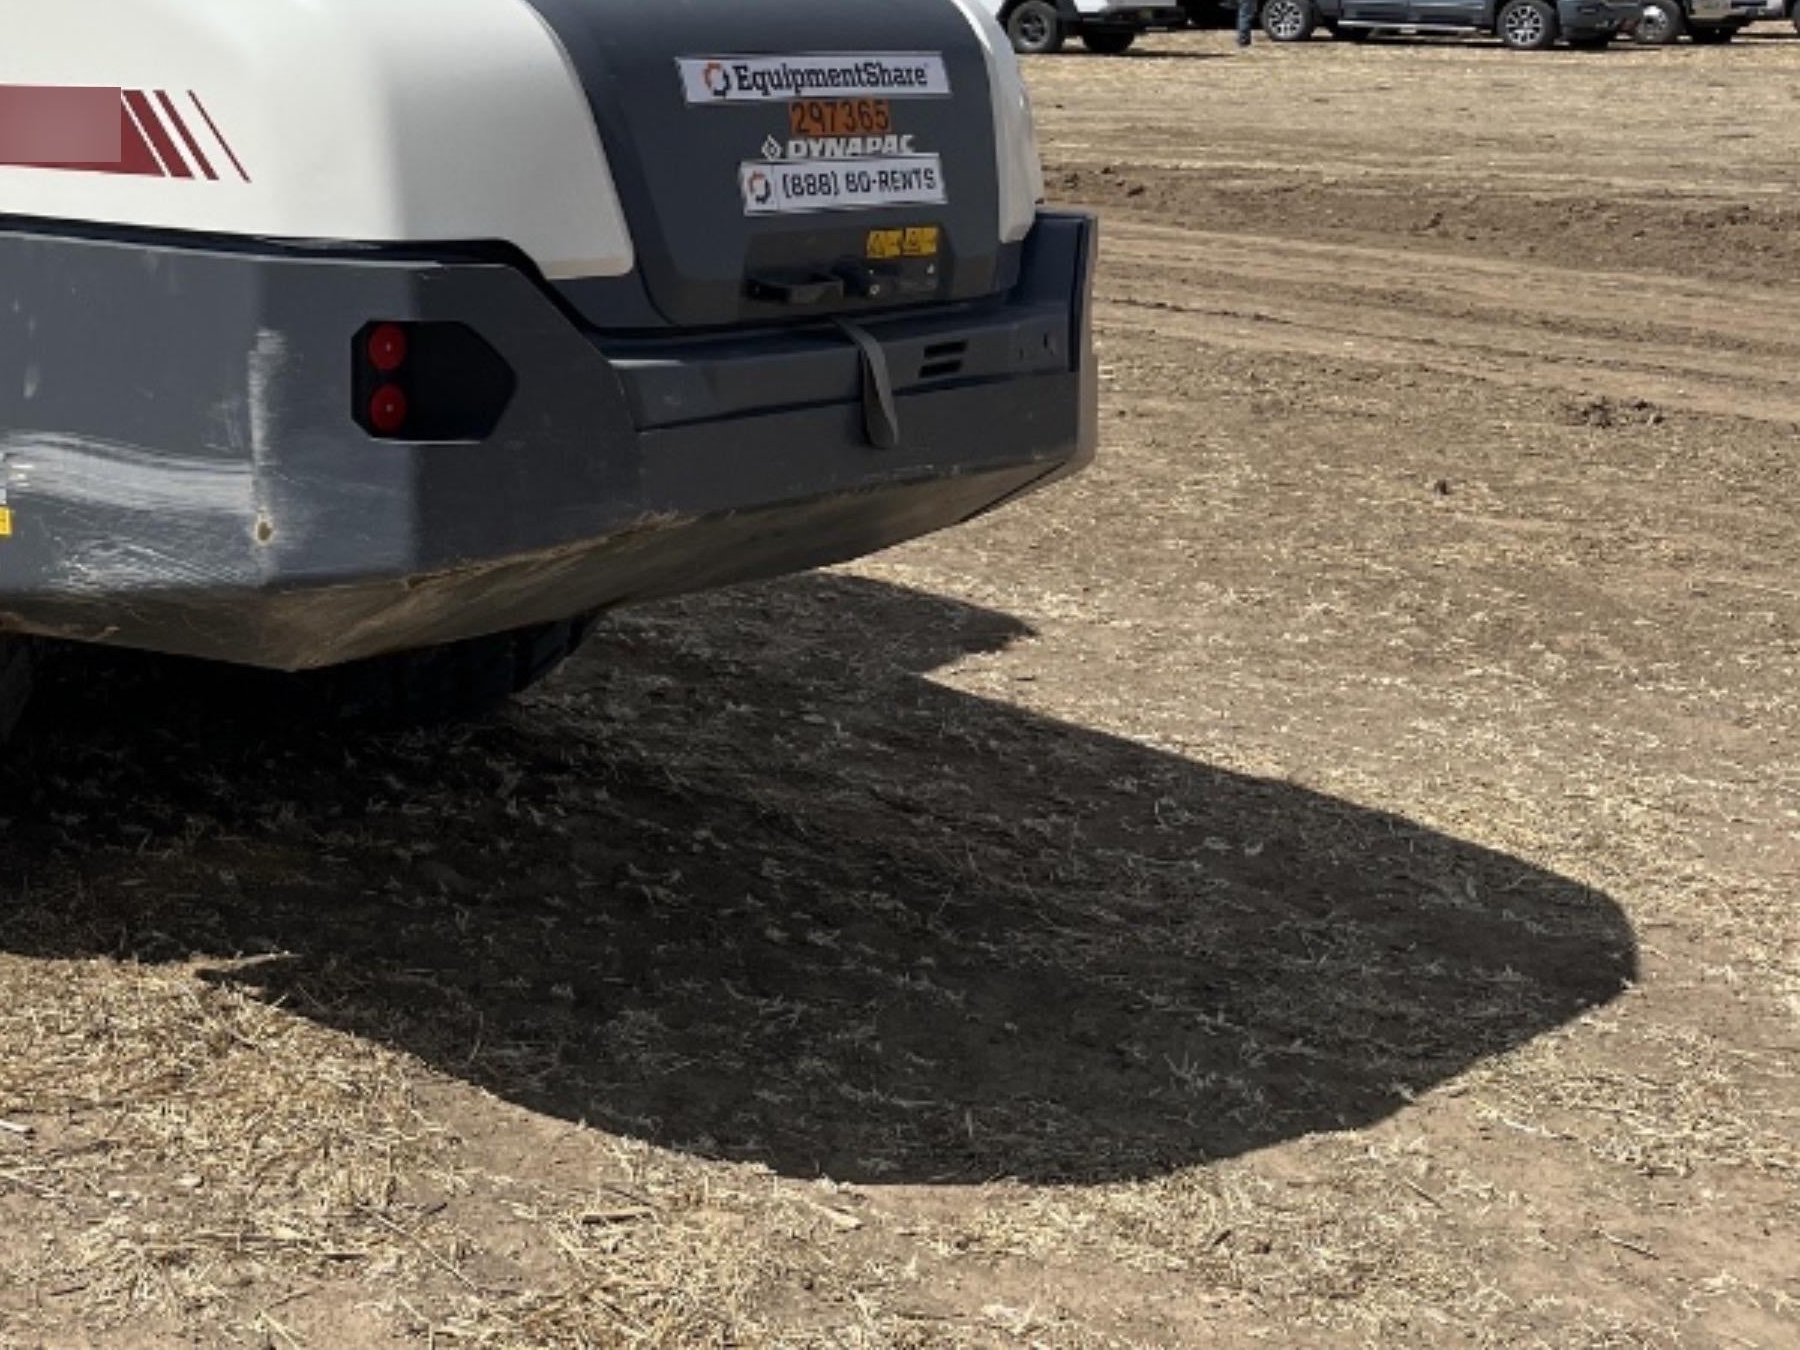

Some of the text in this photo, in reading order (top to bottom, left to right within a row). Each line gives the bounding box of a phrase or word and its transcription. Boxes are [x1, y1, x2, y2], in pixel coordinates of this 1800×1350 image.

[733, 62, 928, 96] EquipmentShare
[790, 101, 889, 133] 297365
[782, 171, 840, 199] (888)
